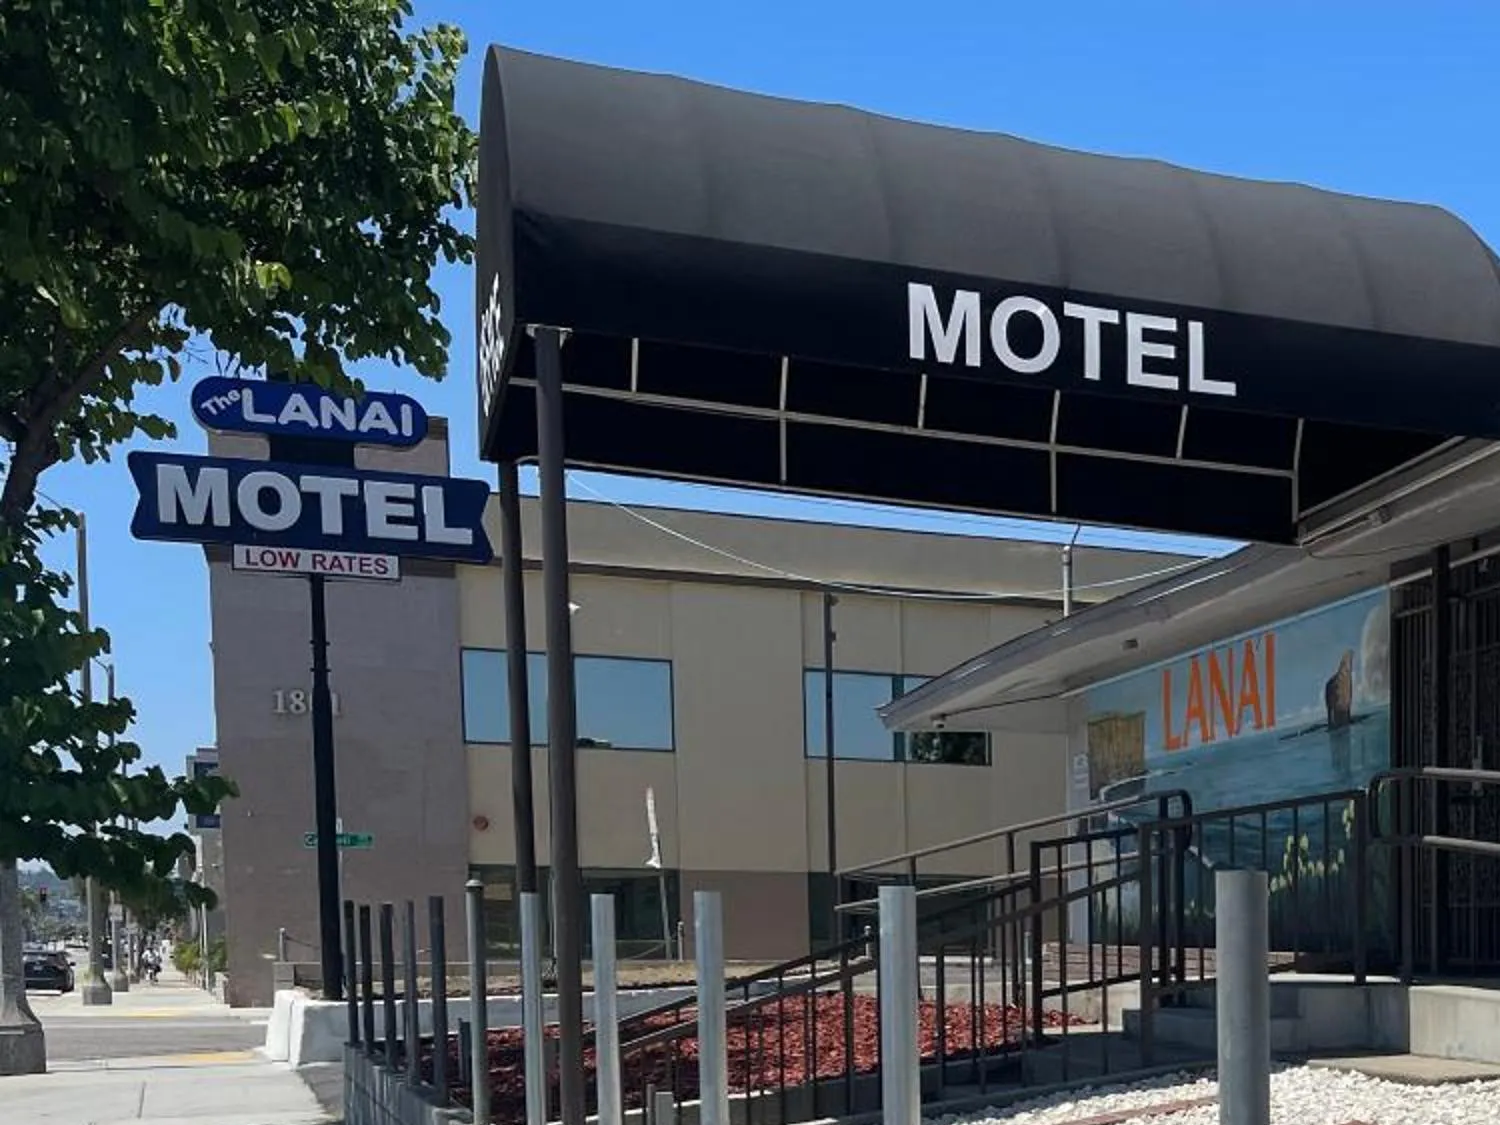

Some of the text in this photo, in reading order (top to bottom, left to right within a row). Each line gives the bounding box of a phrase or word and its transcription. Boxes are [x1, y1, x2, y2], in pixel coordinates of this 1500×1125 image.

[907, 282, 1237, 396] MOTEL
[202, 387, 413, 437] The LANAI
[156, 464, 473, 545] MOTEL
[246, 550, 388, 575] LOW RATES
[272, 689, 340, 716] 181
[1162, 632, 1275, 750] LANAI
